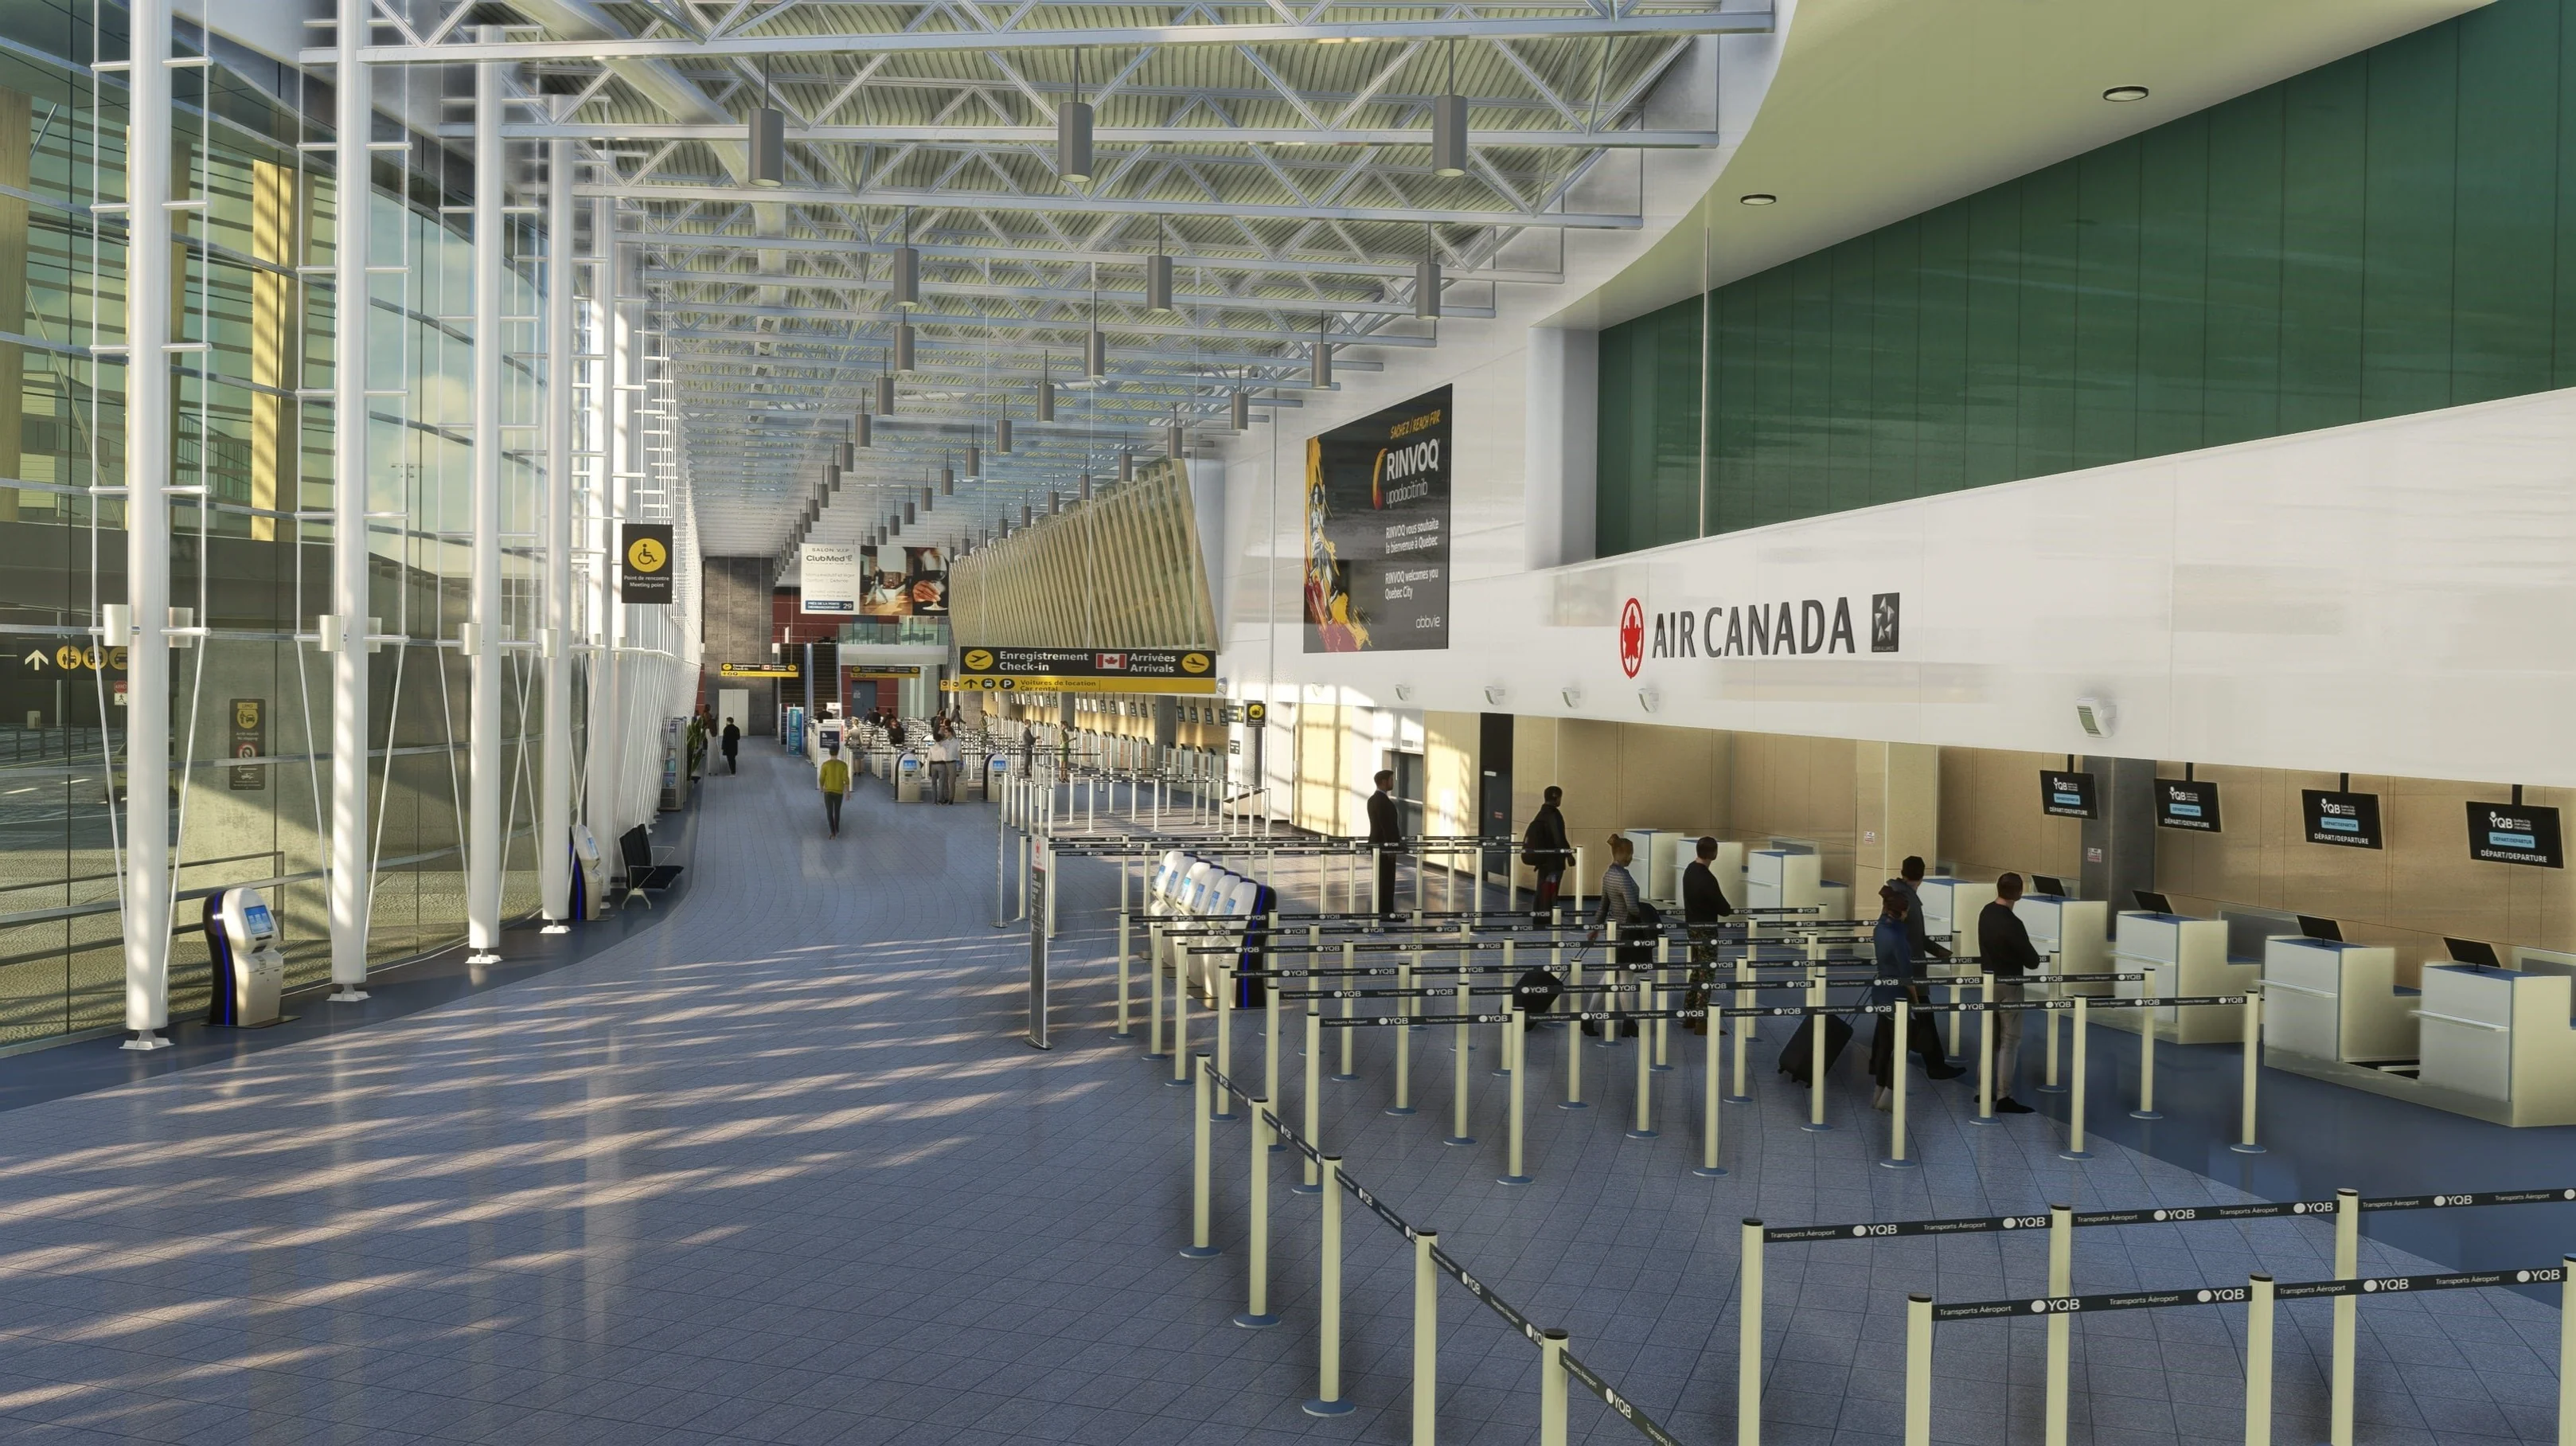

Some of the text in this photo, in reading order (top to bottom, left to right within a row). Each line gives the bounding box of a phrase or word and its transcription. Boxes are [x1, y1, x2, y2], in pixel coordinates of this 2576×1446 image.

[1388, 439, 1438, 481] RINVOQ
[1386, 518, 1438, 538] RINVOQ vous souhaite
[1386, 541, 1390, 554] la
[1391, 541, 1414, 553] bienvenue
[1386, 569, 1438, 584] RINVOQ welcomes you
[1403, 585, 1413, 600] City
[1652, 597, 1856, 659] AIR CANADA
[1000, 651, 1089, 662] Enregistrement
[1130, 653, 1176, 662] Arrivées
[999, 662, 1049, 670] Check-in
[2054, 781, 2067, 790] YQB
[2170, 791, 2186, 801] YQB
[2321, 803, 2340, 814] YQB
[2489, 817, 2513, 828] YQB
[2314, 832, 2369, 844] DÉPART/DEPARTURE
[2480, 849, 2547, 862] DÉPART/DEPARTURE
[1806, 1229, 1836, 1238] Aéroport
[1867, 1225, 1897, 1236] YQB
[2016, 1217, 2046, 1228] YQB
[2167, 1210, 2195, 1220] YQB
[2306, 1202, 2333, 1213] YQB
[2445, 1195, 2473, 1206] YQB
[1467, 1276, 1481, 1295] YQB
[1940, 1308, 1978, 1317] Transports
[1980, 1306, 2012, 1315] Aéroport
[2047, 1299, 2080, 1312] YQB
[2110, 1297, 2146, 1306] Transports
[2147, 1295, 2179, 1304] Aéroport
[2213, 1289, 2245, 1301] YQB
[2316, 1284, 2346, 1293] Aéroport
[2379, 1279, 2409, 1291] YQB
[2531, 1269, 2560, 1281] YQB
[1614, 1398, 1631, 1419] YQB
